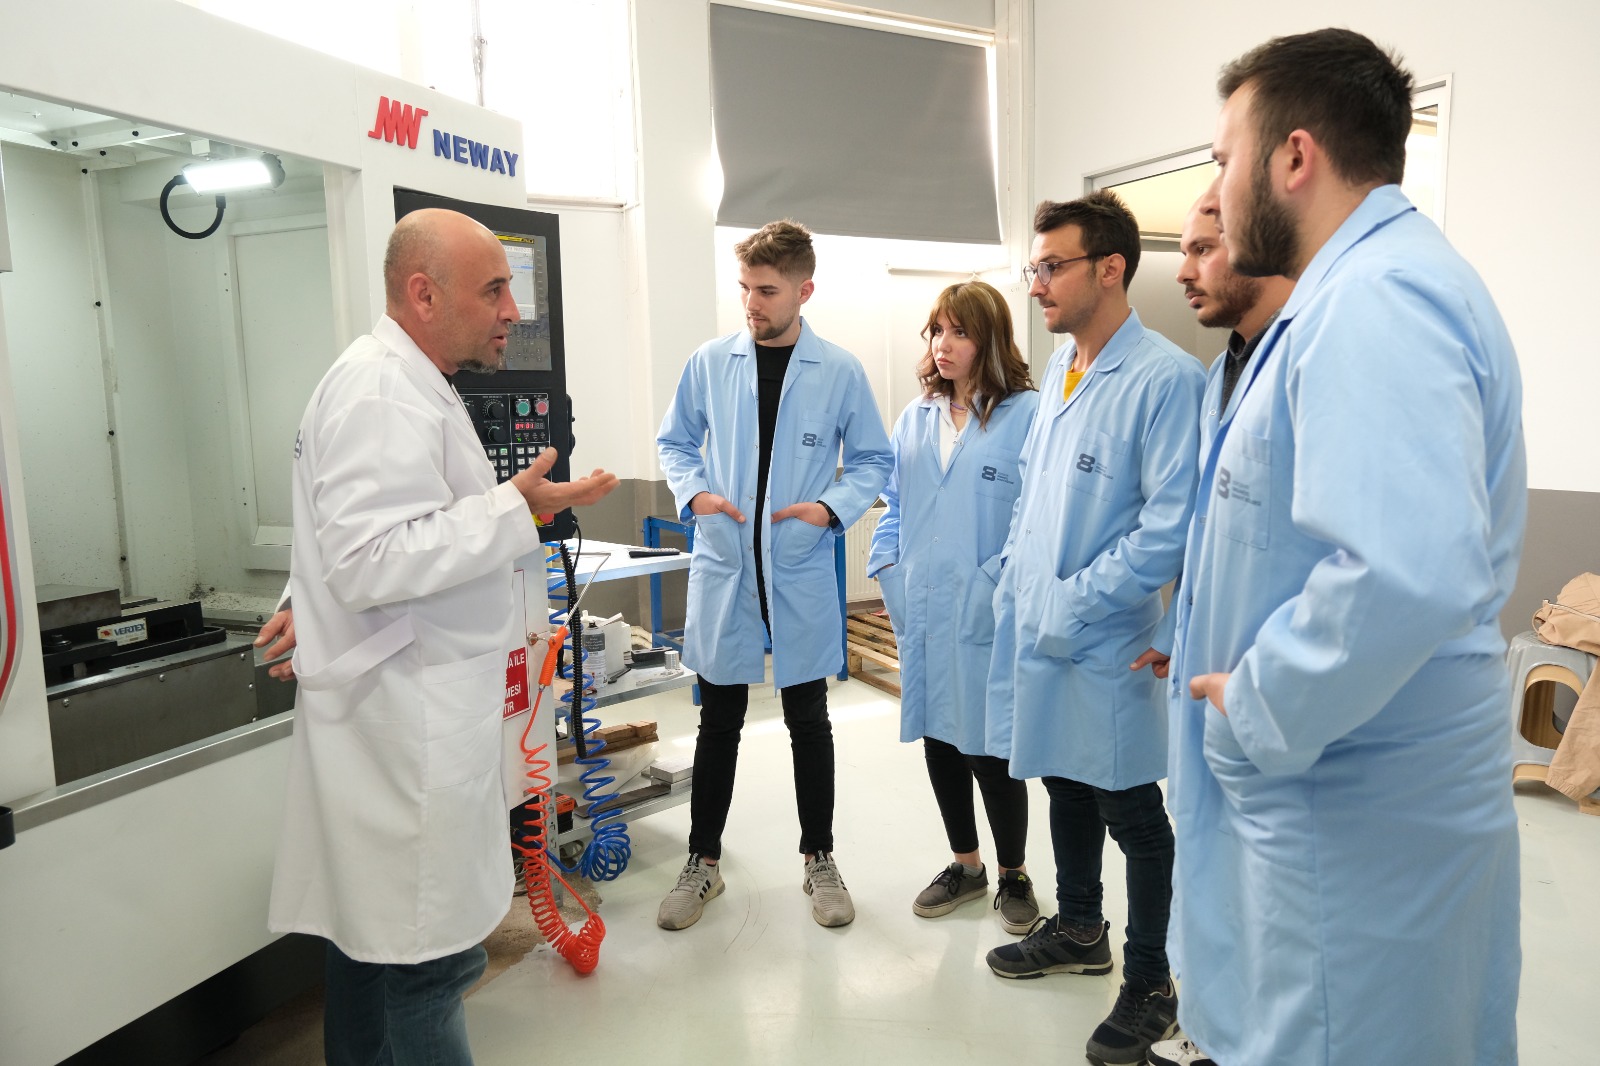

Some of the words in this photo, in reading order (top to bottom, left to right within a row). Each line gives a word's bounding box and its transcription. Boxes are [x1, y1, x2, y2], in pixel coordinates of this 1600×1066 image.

[432, 128, 519, 178] NEWAY
[114, 623, 145, 635] VERTEX
[514, 652, 525, 667] İLE
